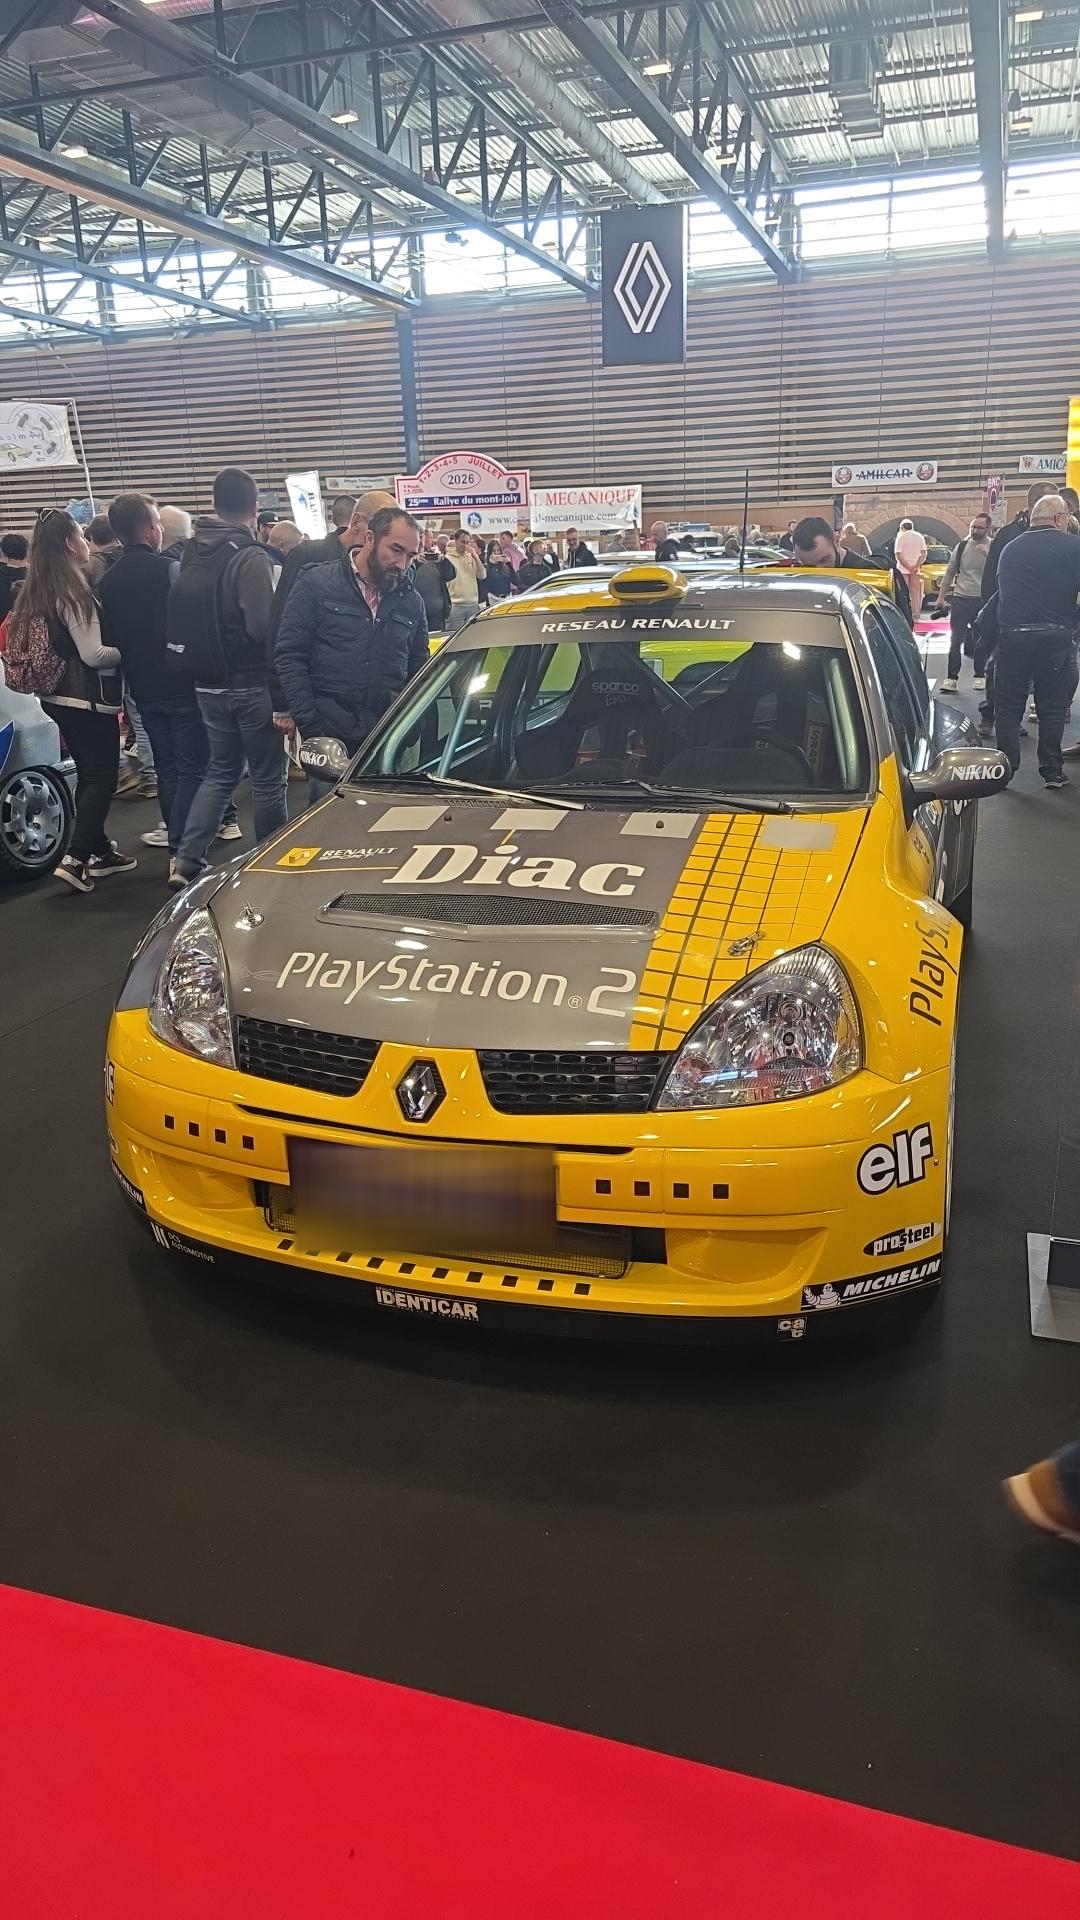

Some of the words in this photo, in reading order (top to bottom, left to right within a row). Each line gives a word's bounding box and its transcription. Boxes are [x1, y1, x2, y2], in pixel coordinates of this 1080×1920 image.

[468, 457, 503, 481] JUILLET
[857, 468, 912, 480] AMILCAR
[447, 473, 475, 486] 2026
[433, 497, 460, 507] Rallye
[462, 496, 474, 505] du
[475, 494, 519, 505] mont-Joly
[545, 489, 636, 507] MECANIQUE
[532, 512, 617, 524] al-mecanique.com
[541, 619, 626, 633] RESEAU
[632, 618, 736, 630] RENAULT
[591, 681, 640, 692] sparco
[951, 764, 1005, 781] NIKKO
[322, 847, 398, 857] RENAULT
[382, 844, 646, 896] Diac
[586, 966, 638, 1018] 2
[858, 1124, 934, 1194] elf
[873, 1222, 935, 1256] prosteel
[171, 1240, 216, 1264] AUTOMOTIVE
[843, 1258, 941, 1298] MICHELIN
[376, 1289, 479, 1319] IDENTICAR
